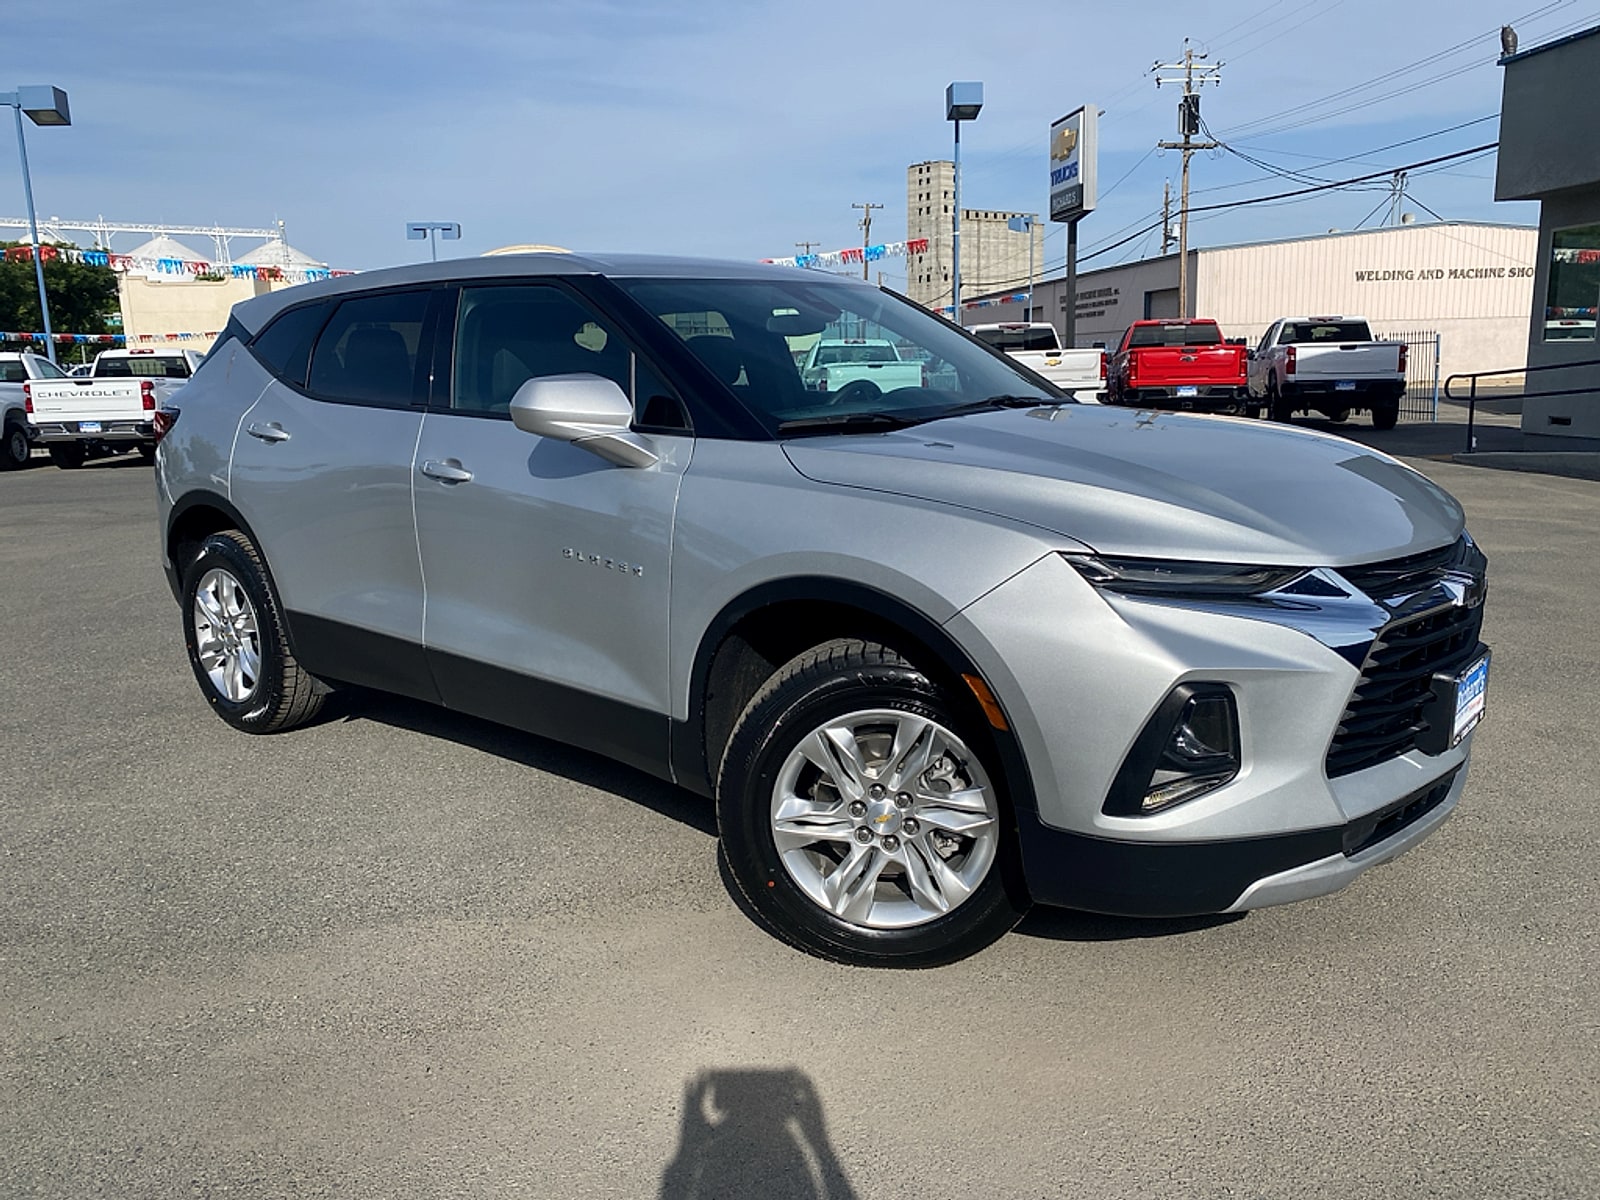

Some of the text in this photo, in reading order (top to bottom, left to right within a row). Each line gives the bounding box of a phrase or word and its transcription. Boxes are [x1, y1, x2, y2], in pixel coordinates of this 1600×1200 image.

[1050, 161, 1078, 187] TRUCKS
[1355, 266, 1534, 282] WELDING AND MACHINE SHO
[37, 389, 133, 398] CHEVROLET
[562, 548, 643, 577] BLAZER
